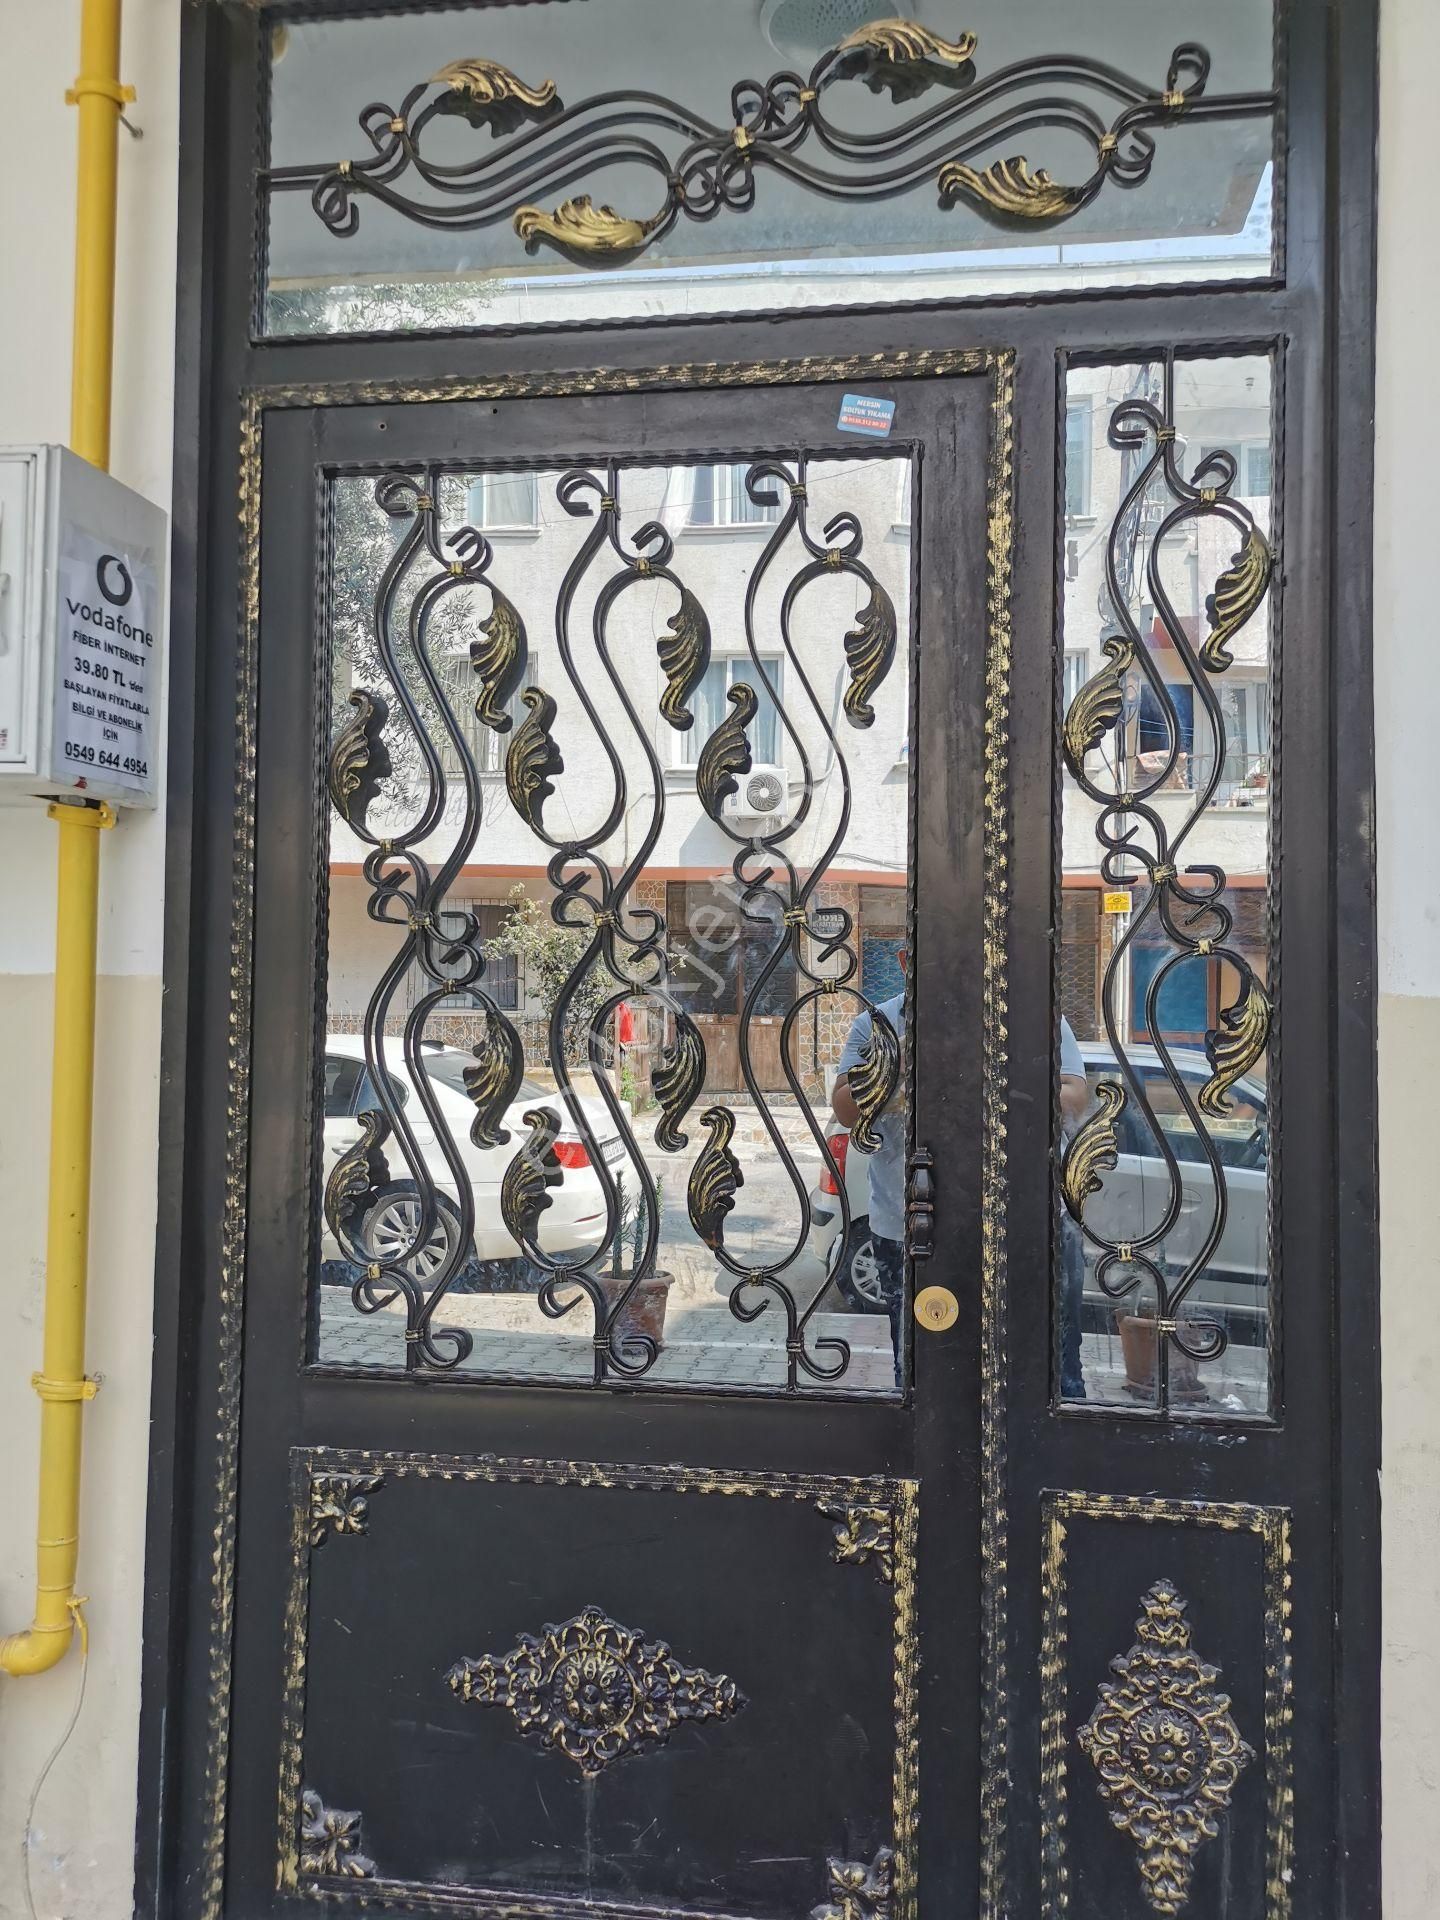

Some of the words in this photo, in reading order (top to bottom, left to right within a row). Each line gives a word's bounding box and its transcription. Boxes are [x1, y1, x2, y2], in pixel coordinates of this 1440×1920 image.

[65, 597, 153, 648] vodafone
[74, 656, 109, 680] 39.80
[112, 669, 126, 687] TL
[63, 679, 107, 701] BAŞLAYAN
[108, 692, 150, 715] FİYATLARLA
[72, 700, 95, 716] BİLGİ
[97, 708, 108, 720] VE
[108, 712, 143, 731] ABONELİK
[65, 741, 95, 762] 0549
[99, 750, 120, 768] 644
[123, 756, 148, 776] 4954
